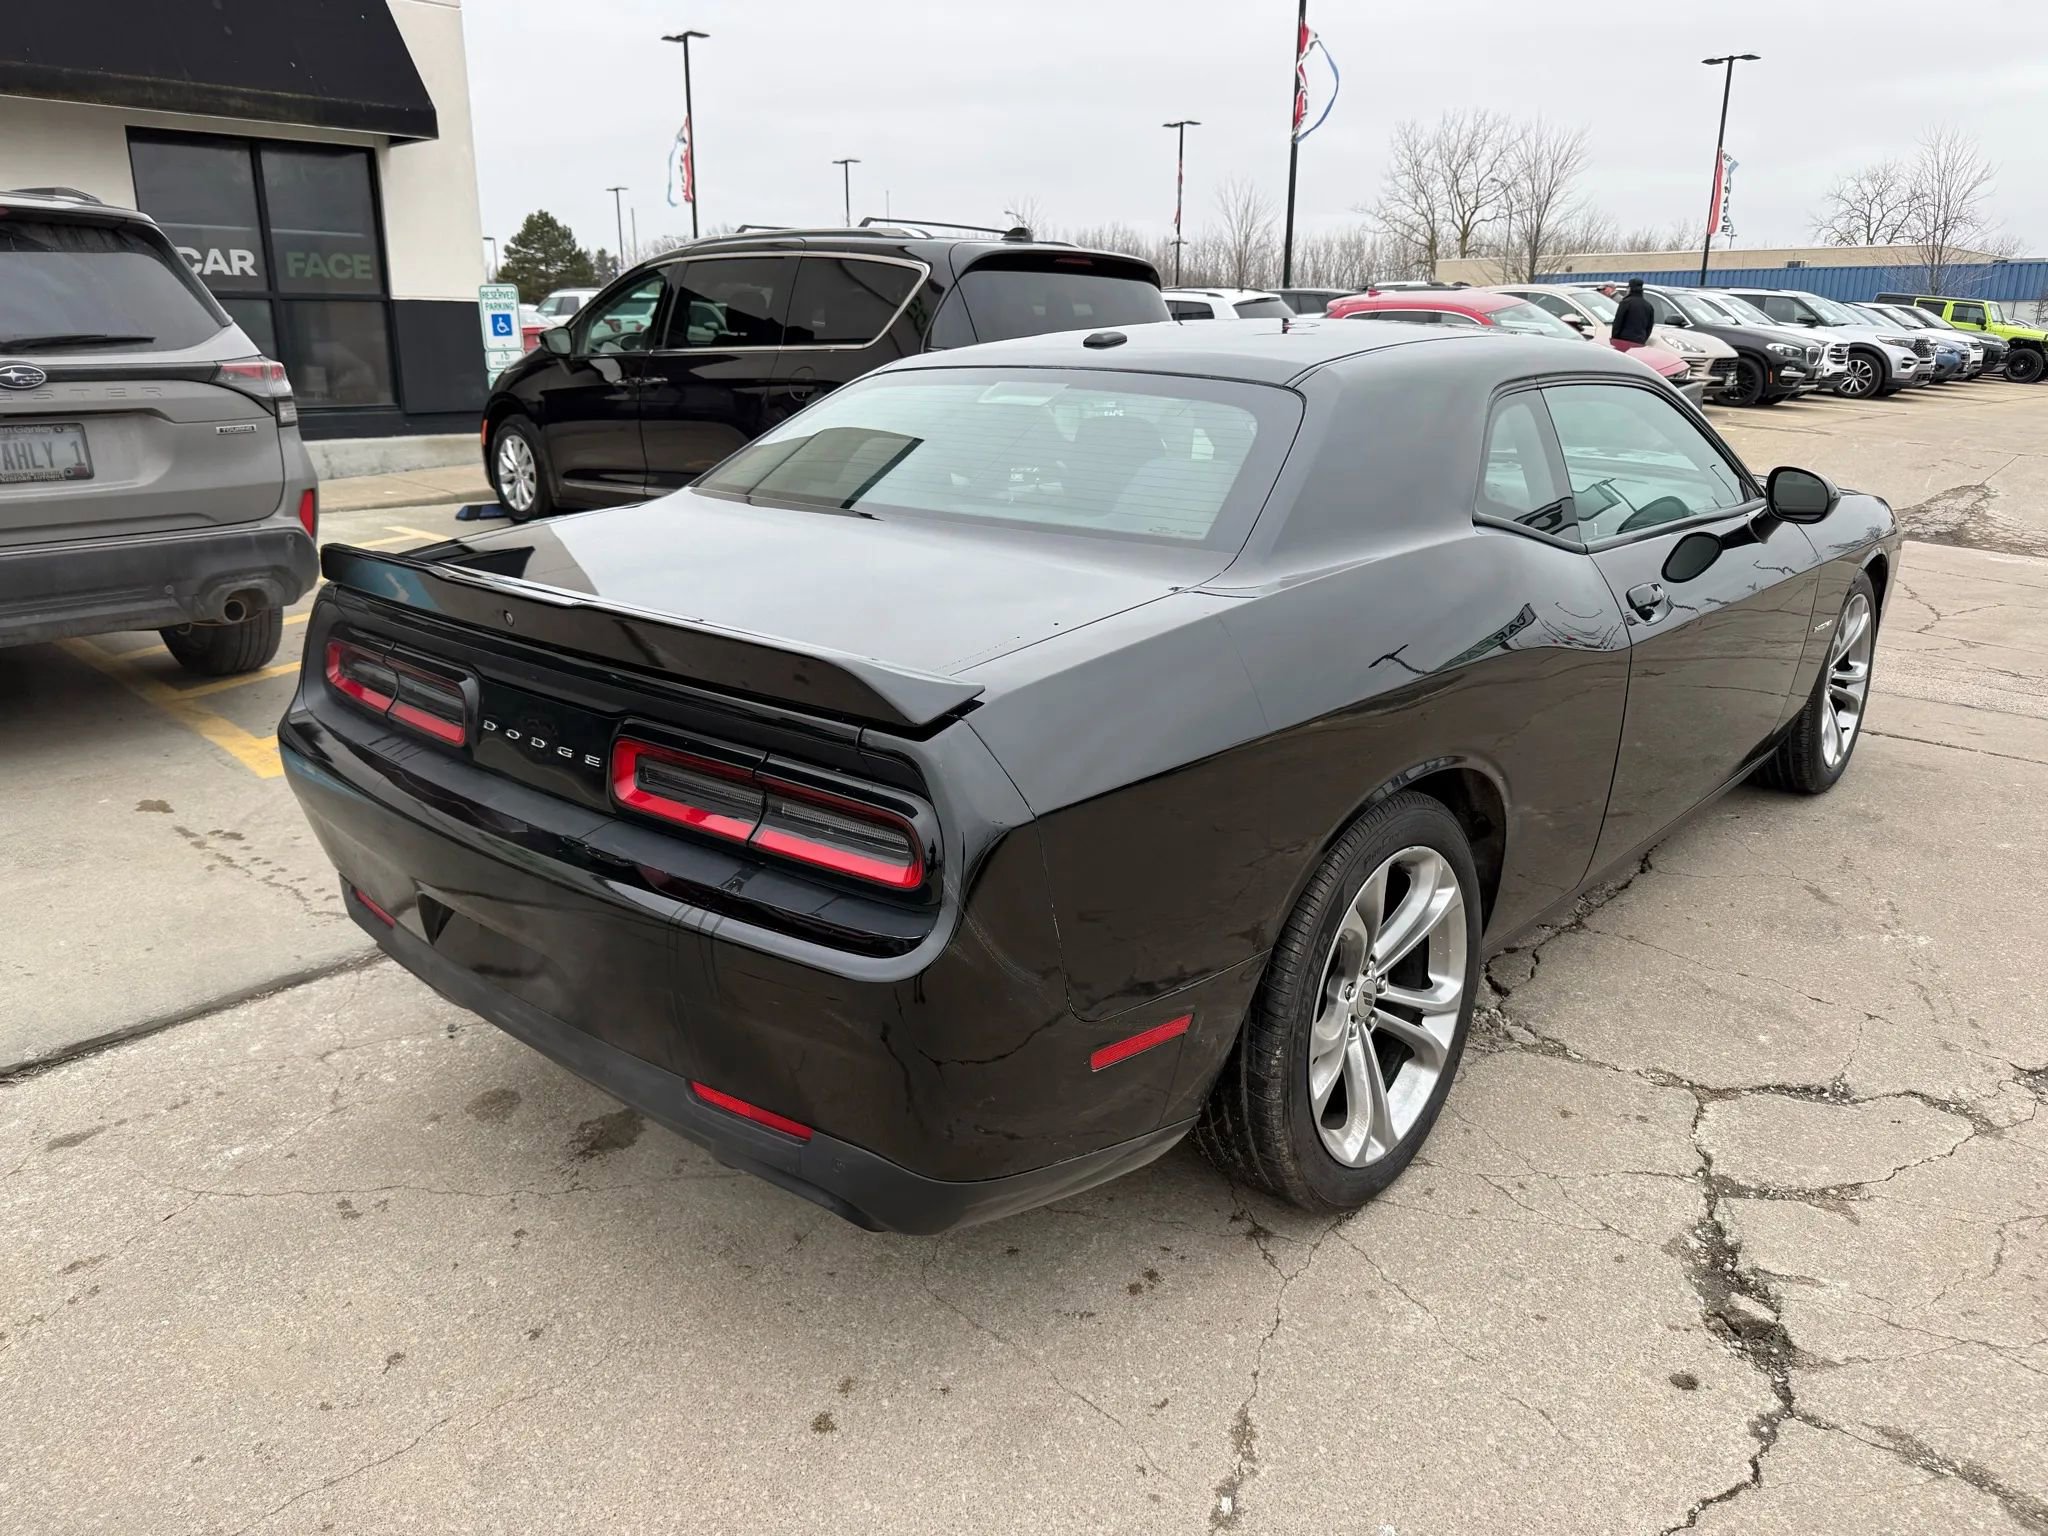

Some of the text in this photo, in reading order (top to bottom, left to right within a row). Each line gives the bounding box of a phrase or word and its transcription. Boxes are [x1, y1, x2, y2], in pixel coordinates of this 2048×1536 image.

[175, 246, 374, 281] CAR FACE
[480, 291, 515, 299] RESERVED
[485, 302, 514, 310] PARKING
[1, 441, 55, 471] AHLY
[483, 719, 601, 768] DODGE
